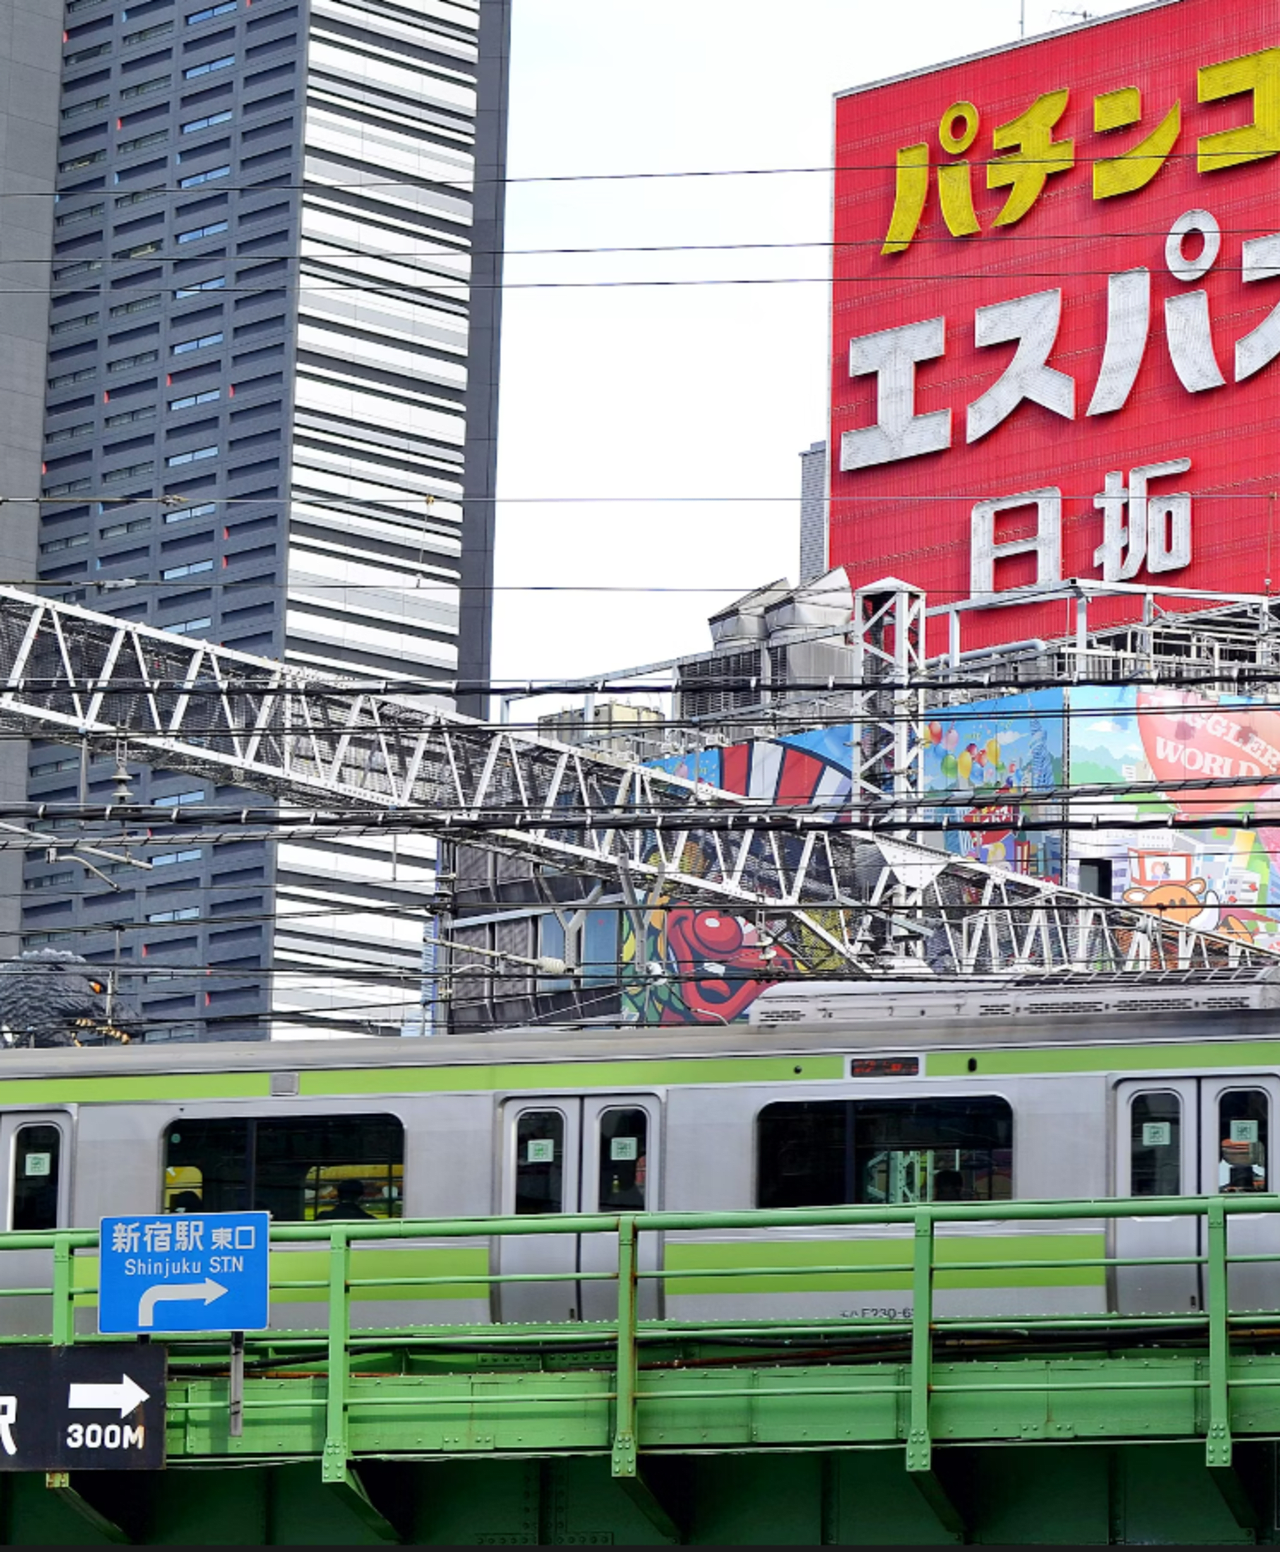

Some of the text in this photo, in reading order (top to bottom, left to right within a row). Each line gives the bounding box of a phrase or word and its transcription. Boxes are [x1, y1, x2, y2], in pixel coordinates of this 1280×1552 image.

[970, 457, 1193, 600] 日拓
[1156, 736, 1262, 778] WORLD
[112, 1221, 256, 1253] 新宿駅 東口
[124, 1258, 201, 1279] Shinjuku
[66, 1423, 145, 1450] 300M
